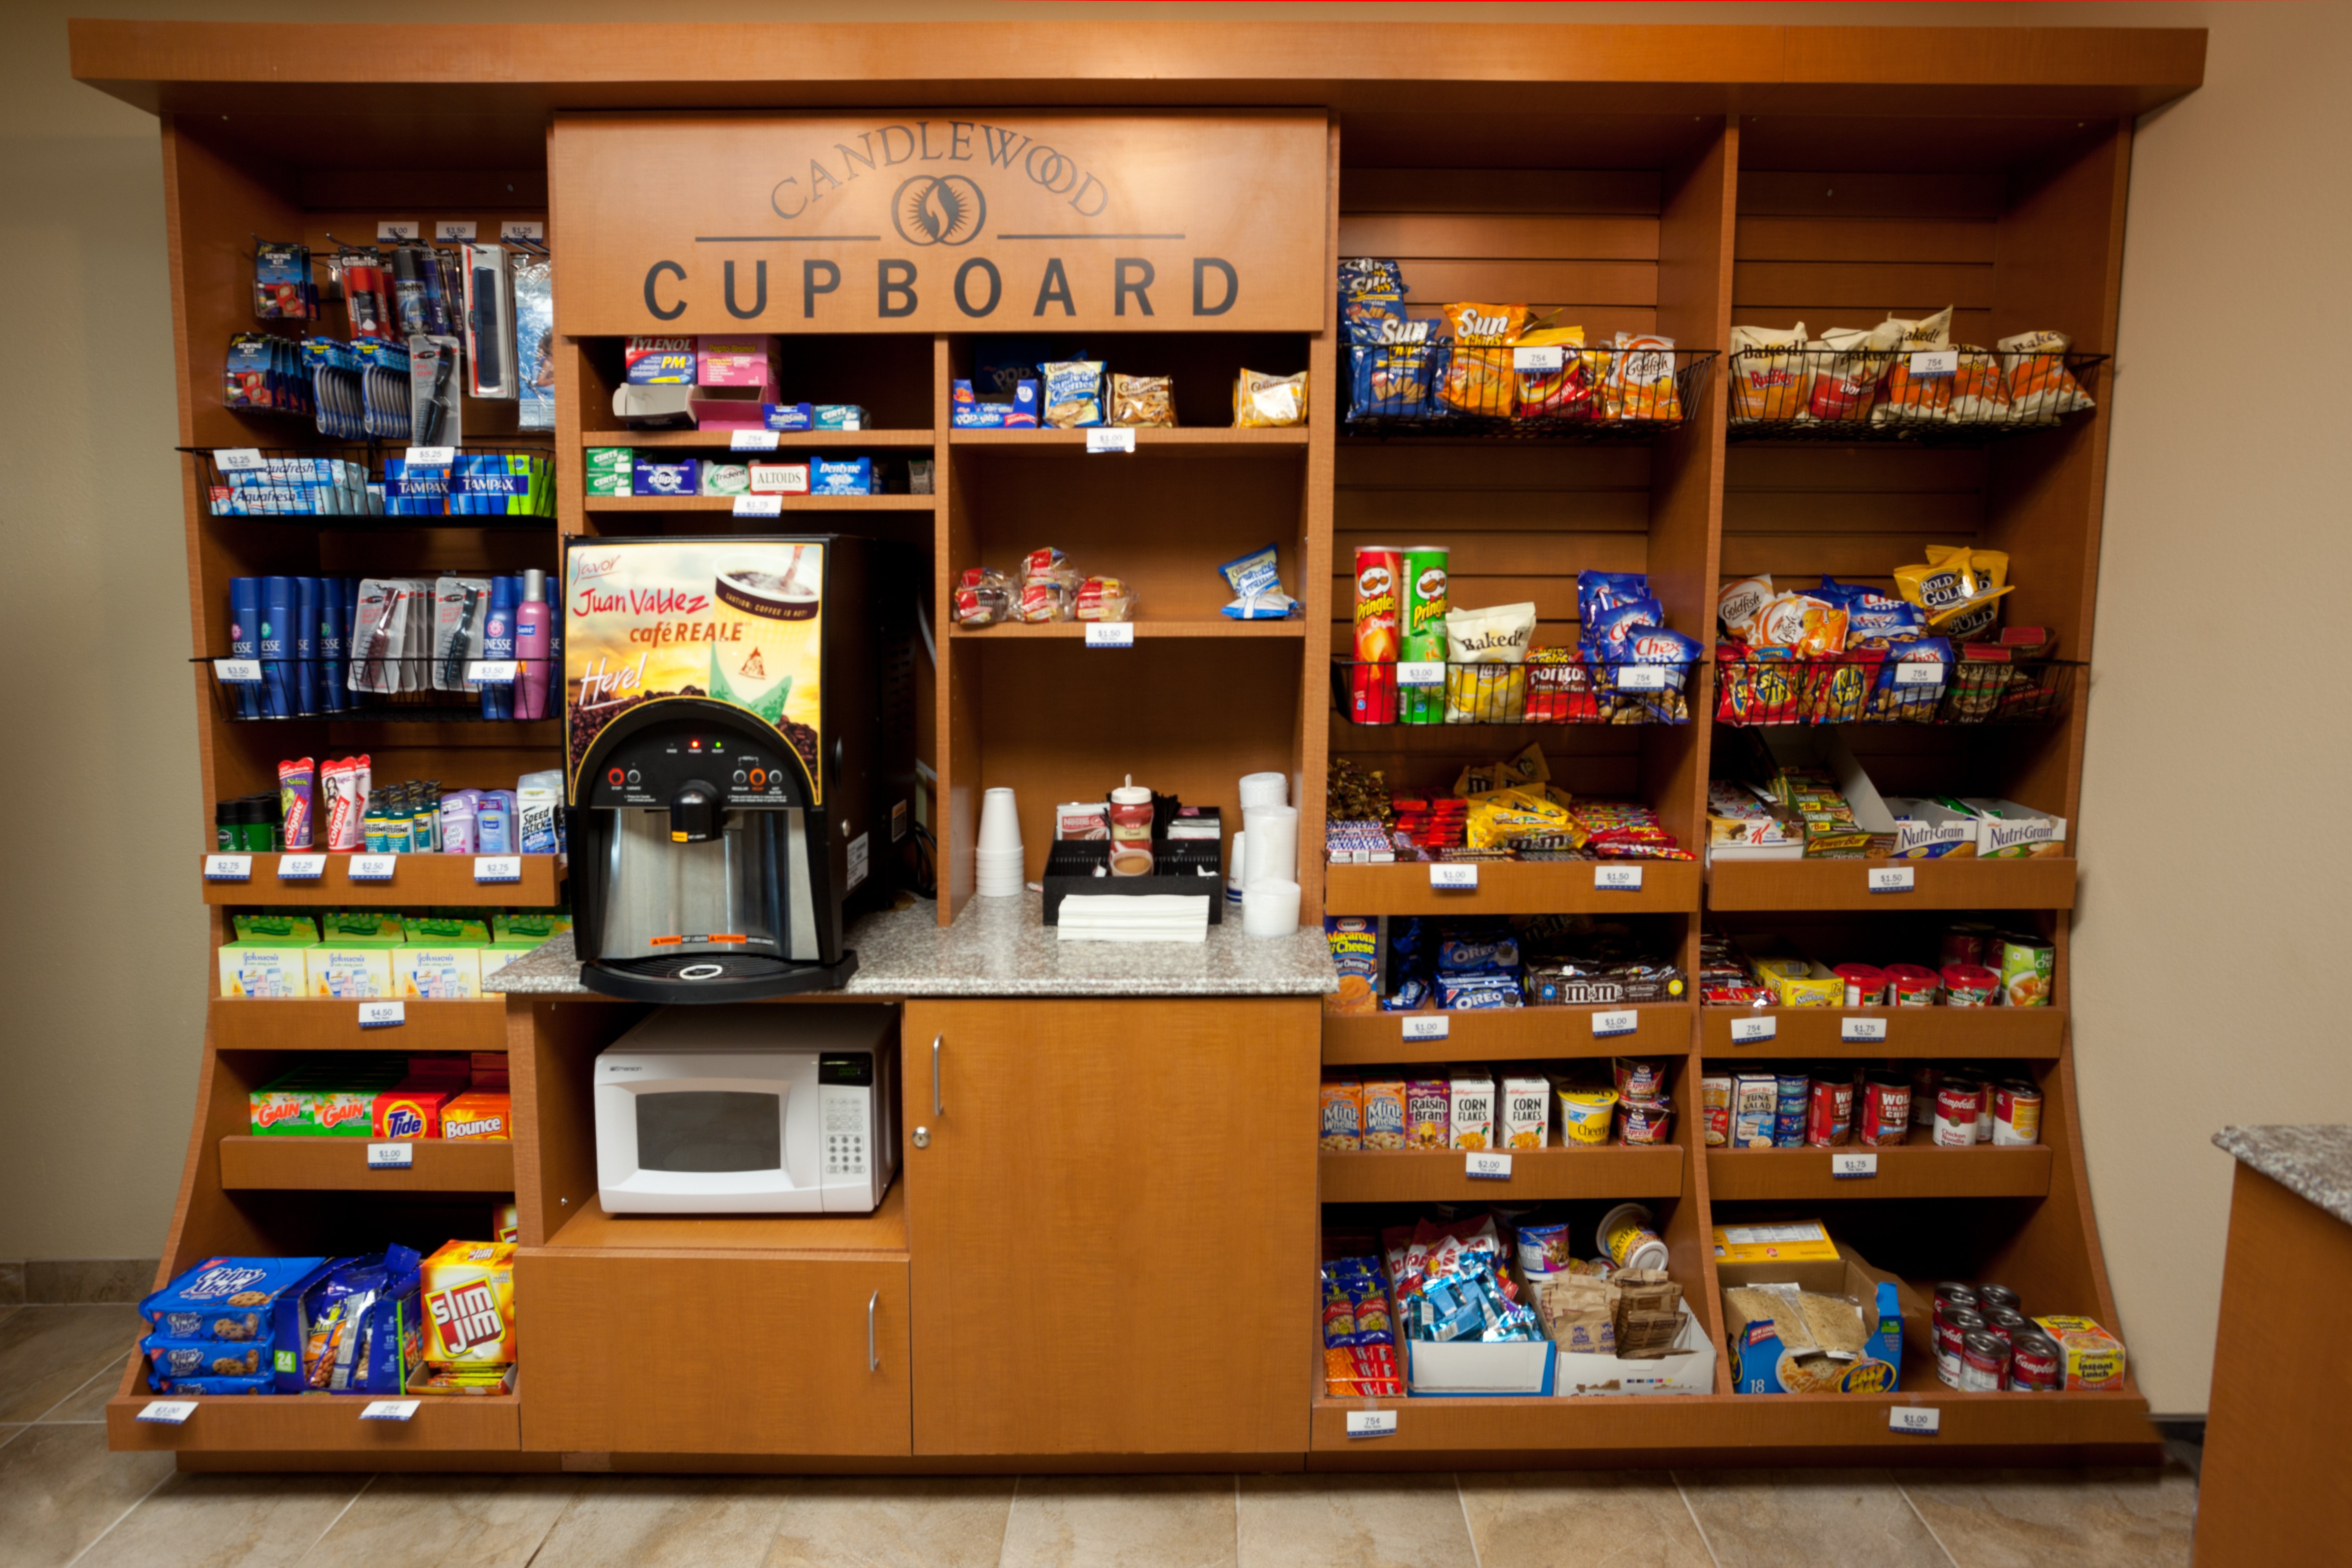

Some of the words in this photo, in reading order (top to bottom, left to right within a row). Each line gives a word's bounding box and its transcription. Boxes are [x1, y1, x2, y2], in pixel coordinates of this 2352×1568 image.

[771, 121, 1108, 220] CANDLEWOOD
[342, 256, 377, 267] Gillette
[643, 257, 1239, 321] CUPBOARD
[1457, 308, 1508, 338] Sun
[1379, 319, 1429, 345] Sun
[628, 335, 692, 352] TYLENOL
[1743, 339, 1804, 359] Baked!
[661, 356, 687, 369] PM
[1627, 355, 1668, 376] Goldfish
[1927, 358, 1942, 367] 75¢
[1750, 368, 1795, 389] Ruffles
[821, 407, 847, 420] CERTS
[593, 450, 618, 463] CERTS
[819, 463, 861, 475] Dentyne
[593, 474, 618, 486] CERTS
[648, 474, 682, 485] eclipse
[715, 469, 745, 483] Trident
[757, 471, 801, 485] ALTOIDS
[399, 482, 449, 494] TAMPAX
[463, 479, 514, 491] TAMPAX
[236, 489, 296, 503] Aquafresh
[573, 553, 621, 586] Savor
[1919, 575, 1954, 593] ROLD
[572, 588, 626, 617] Juan
[630, 588, 709, 616] Valdez
[1723, 592, 1760, 620] Goldfish
[754, 604, 782, 617] COFFEE
[1356, 593, 1395, 626] Pringles
[1413, 595, 1447, 628] Pringle
[630, 621, 672, 648] café
[675, 622, 743, 642] REALE
[1098, 629, 1121, 637] $1.50
[1462, 630, 1524, 652] Baked!
[1635, 636, 1684, 656] Chex
[579, 652, 648, 706] Here!
[1409, 669, 1432, 677] $3.00
[1529, 666, 1587, 686] Doritos
[285, 800, 304, 844] Colgate
[328, 801, 347, 845] Colgate
[1751, 822, 1770, 845] K
[1902, 826, 1964, 849] Nutri-Grain
[1990, 826, 2053, 849] Nutri-Grain
[526, 835, 548, 847] Spring
[1813, 835, 1865, 849] PowerBar
[1443, 871, 1466, 879] $1.00
[1606, 872, 1629, 880] $1.50
[1880, 874, 1902, 882] $1.50
[1327, 931, 1376, 944] Macaroni
[1336, 941, 1375, 954] Cheese
[243, 951, 278, 965] Johnson's
[329, 952, 365, 965] Johnson's
[417, 952, 454, 965] Johnson's
[1452, 946, 1496, 963] OREO
[1830, 982, 1842, 992] 12
[1455, 991, 1502, 1009] OREO
[1795, 993, 1825, 1005] Newtons
[1605, 1017, 1627, 1026] $1.00
[1746, 1024, 1760, 1033] 75¢
[1854, 1024, 1876, 1033] $1.75
[1626, 1080, 1655, 1091] Express
[1411, 1098, 1446, 1110] Raisin
[1459, 1098, 1486, 1111] CORN
[1514, 1098, 1541, 1111] CORN
[1882, 1093, 1910, 1105] WOL
[1938, 1092, 1976, 1109] Campbell's
[1743, 1102, 1771, 1110] SALAD
[258, 1101, 301, 1128] GAIN
[323, 1101, 365, 1128] GAIN
[1367, 1114, 1401, 1127] Wheats
[1415, 1110, 1443, 1122] Bran
[1458, 1111, 1487, 1122] FLAKES
[1513, 1111, 1541, 1122] FLAKES
[387, 1110, 422, 1138] Tide
[445, 1118, 501, 1138] Bounce
[1324, 1117, 1357, 1130] Wheats
[1623, 1128, 1651, 1138] Express
[1941, 1134, 1965, 1144] Noodle
[1942, 1128, 1966, 1139] Chicken
[1477, 1160, 1500, 1169] $2.00
[1845, 1160, 1866, 1169] $1.75
[1612, 1225, 1636, 1258] Cheerios
[199, 1267, 263, 1282] Chips
[167, 1312, 197, 1324] Chips
[168, 1348, 198, 1361] Chips
[277, 1352, 292, 1366] 24
[2078, 1362, 2114, 1371] Instant
[1849, 1364, 1887, 1388] EASY
[1750, 1379, 1765, 1394] 18
[1365, 1417, 1381, 1426] 75¢
[1904, 1414, 1928, 1424] $1.00
